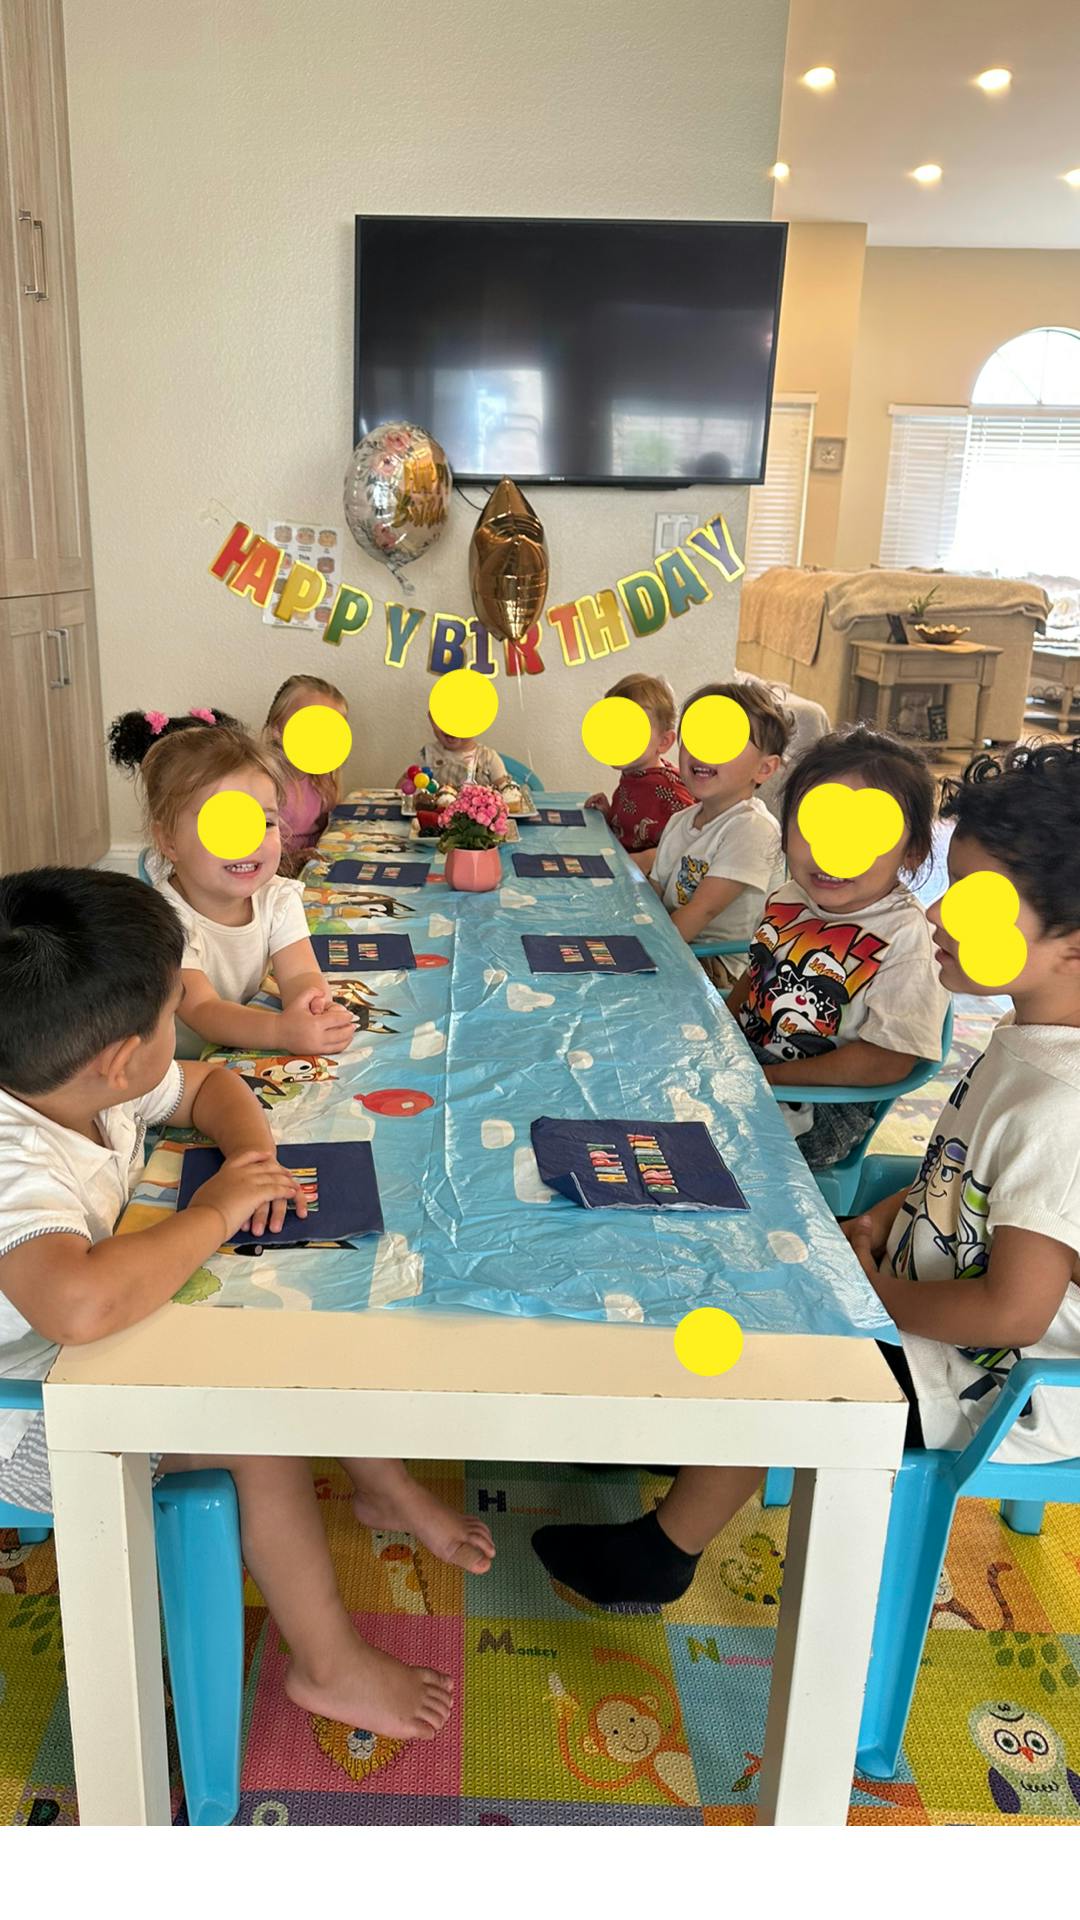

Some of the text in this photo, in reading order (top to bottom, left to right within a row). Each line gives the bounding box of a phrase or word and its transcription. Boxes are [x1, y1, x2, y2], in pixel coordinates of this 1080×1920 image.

[209, 513, 747, 678] HAPPY BIRTHDAY
[586, 1143, 629, 1183] HAPPY
[626, 1133, 679, 1194] BIRTHDAY
[478, 1627, 558, 1660] Monkey
